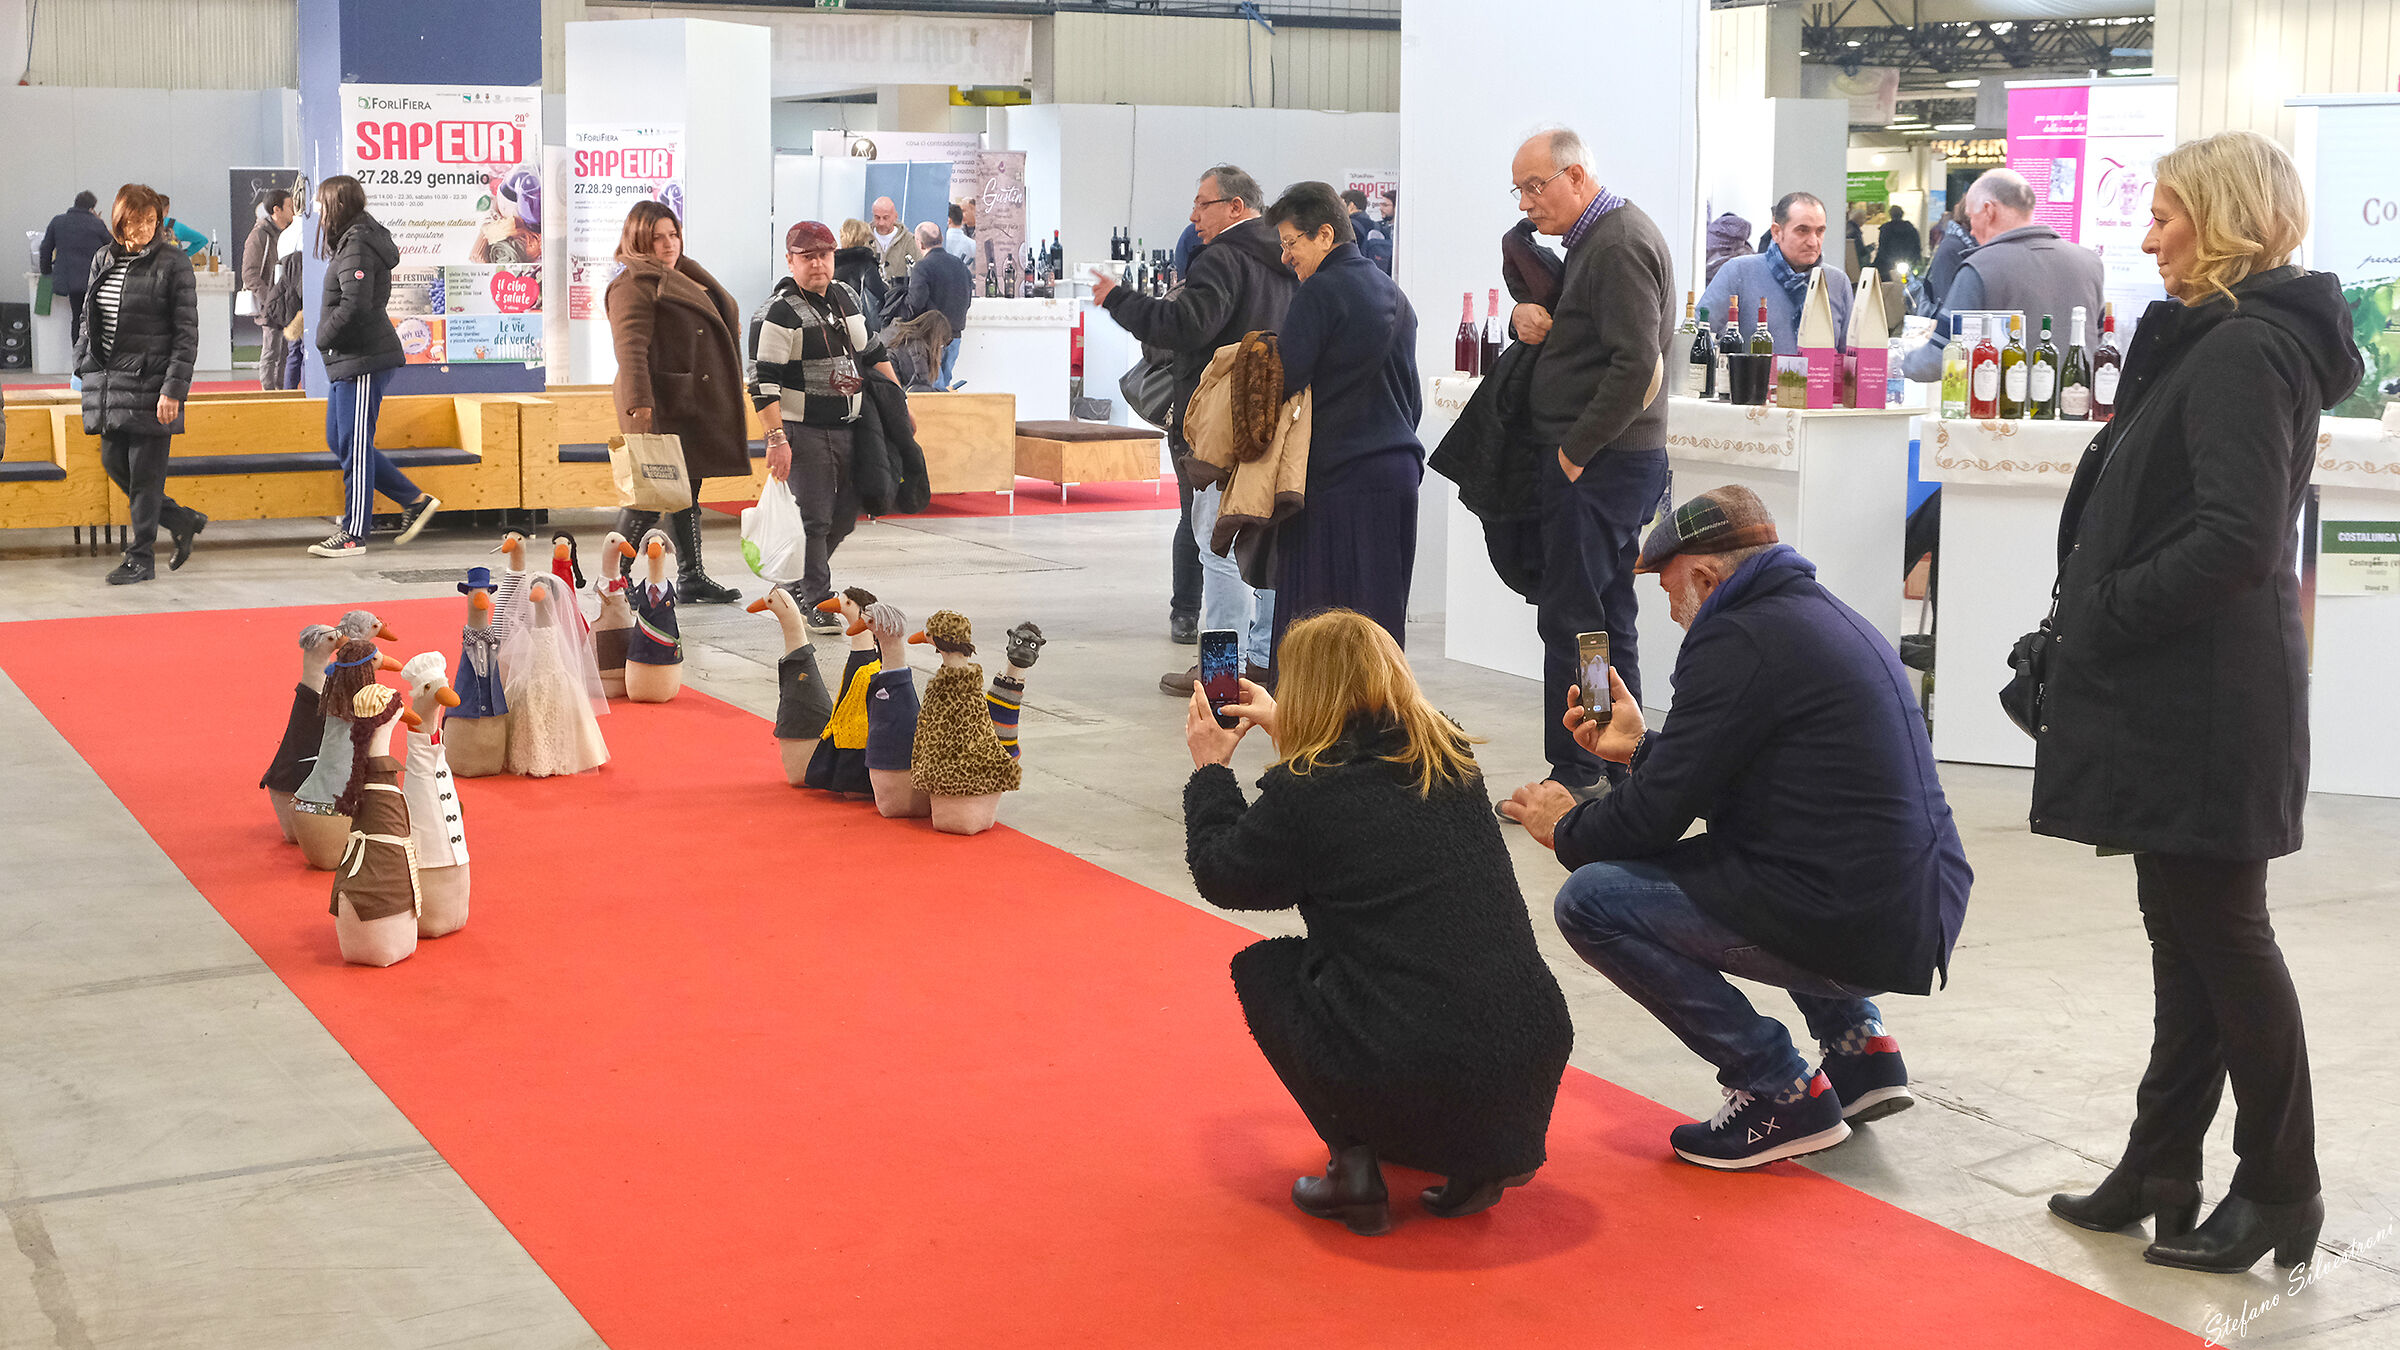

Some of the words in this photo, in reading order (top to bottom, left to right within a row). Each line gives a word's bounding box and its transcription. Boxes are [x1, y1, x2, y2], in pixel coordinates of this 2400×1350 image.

[357, 169, 422, 185] 27.28.29
[427, 170, 490, 188] gennaio
[575, 184, 612, 194] 27.28.29
[615, 184, 653, 196] gennaio
[2363, 198, 2399, 226] Co
[408, 220, 445, 229] tradizione
[405, 231, 444, 241] acquistare
[399, 244, 441, 255] apeur.it
[507, 280, 526, 292] cibo
[503, 293, 530, 305] salute
[500, 321, 508, 332] Le
[512, 321, 525, 332] vie
[494, 334, 507, 345] del
[510, 334, 535, 346] verde
[2338, 532, 2397, 542] COSTALUNGA
